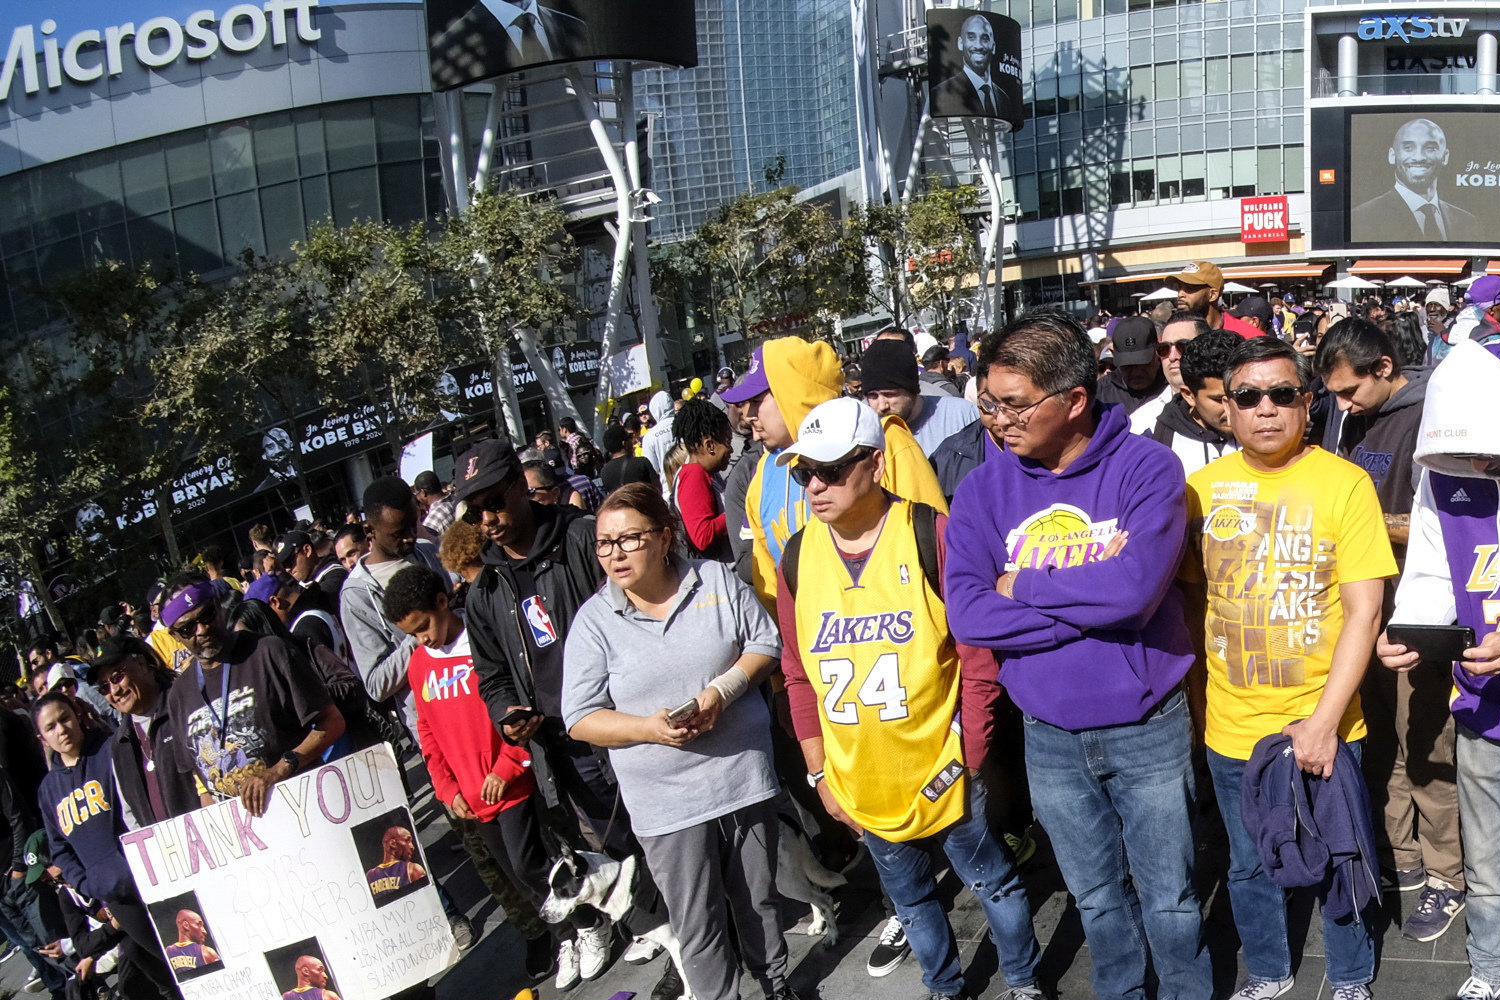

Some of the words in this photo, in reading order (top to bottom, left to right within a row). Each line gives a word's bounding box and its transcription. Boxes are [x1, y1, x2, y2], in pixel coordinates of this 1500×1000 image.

[1357, 13, 1469, 44] axs.tv
[1000, 62, 1018, 77] KOBE
[1243, 202, 1283, 212] WOLFGANG
[1243, 211, 1284, 231] PUCK
[568, 361, 587, 373] KOBE
[300, 427, 348, 455] KOBE
[1444, 429, 1467, 437] CLUB
[1010, 534, 1105, 569] LAKER
[1039, 533, 1059, 543] LOS
[537, 634, 552, 646] NBA
[810, 609, 915, 655] LAKERS
[424, 663, 474, 701] AIR
[819, 652, 909, 725] 24
[56, 780, 112, 836] UCR
[123, 800, 268, 886] THANK
[278, 749, 385, 838] YOU
[260, 870, 370, 943] LAKERS
[350, 921, 384, 946] NBA
[382, 901, 415, 932] MVP
[415, 914, 445, 941] STAR
